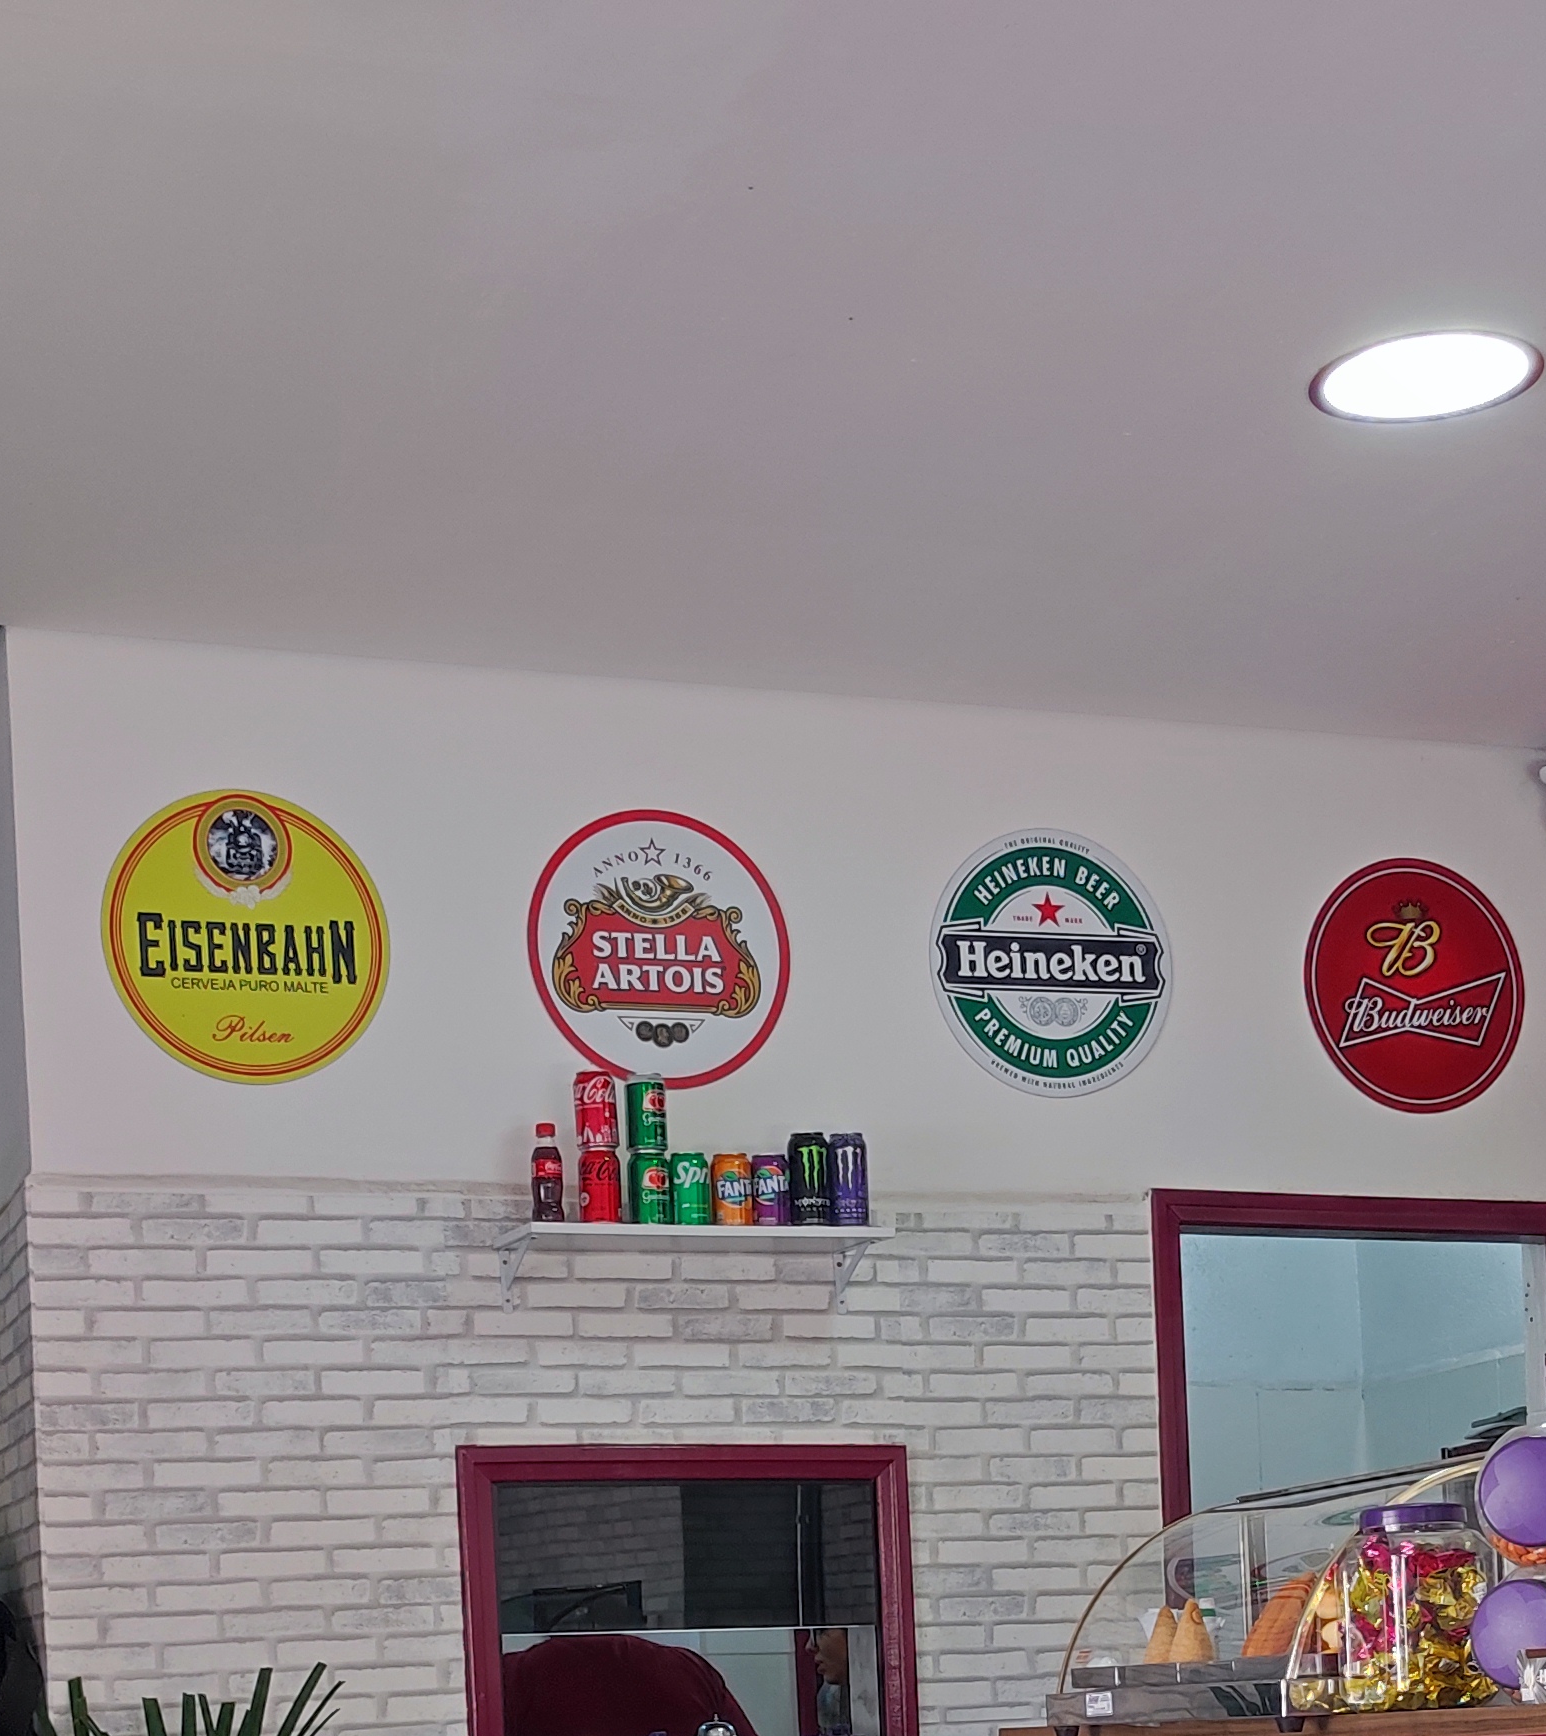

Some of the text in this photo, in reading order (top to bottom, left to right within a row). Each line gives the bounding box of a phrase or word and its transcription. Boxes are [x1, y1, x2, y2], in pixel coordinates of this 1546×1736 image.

[1020, 836, 1056, 846] ORIGINAL
[1059, 839, 1091, 855] QUALITY
[592, 850, 713, 882] ANNO 1366
[973, 855, 1121, 911] HEINEKEN BEER
[136, 911, 358, 985] EISENBAHN
[592, 930, 722, 963] STELLA
[956, 938, 1147, 983] Heineken
[171, 976, 329, 994] CERVEJA PURO MALTE
[592, 963, 725, 994] ARTOIS
[211, 1014, 294, 1044] Pilsen
[1344, 996, 1489, 1032] Budweiser
[973, 1007, 1135, 1069] PREMIUM QUALITY
